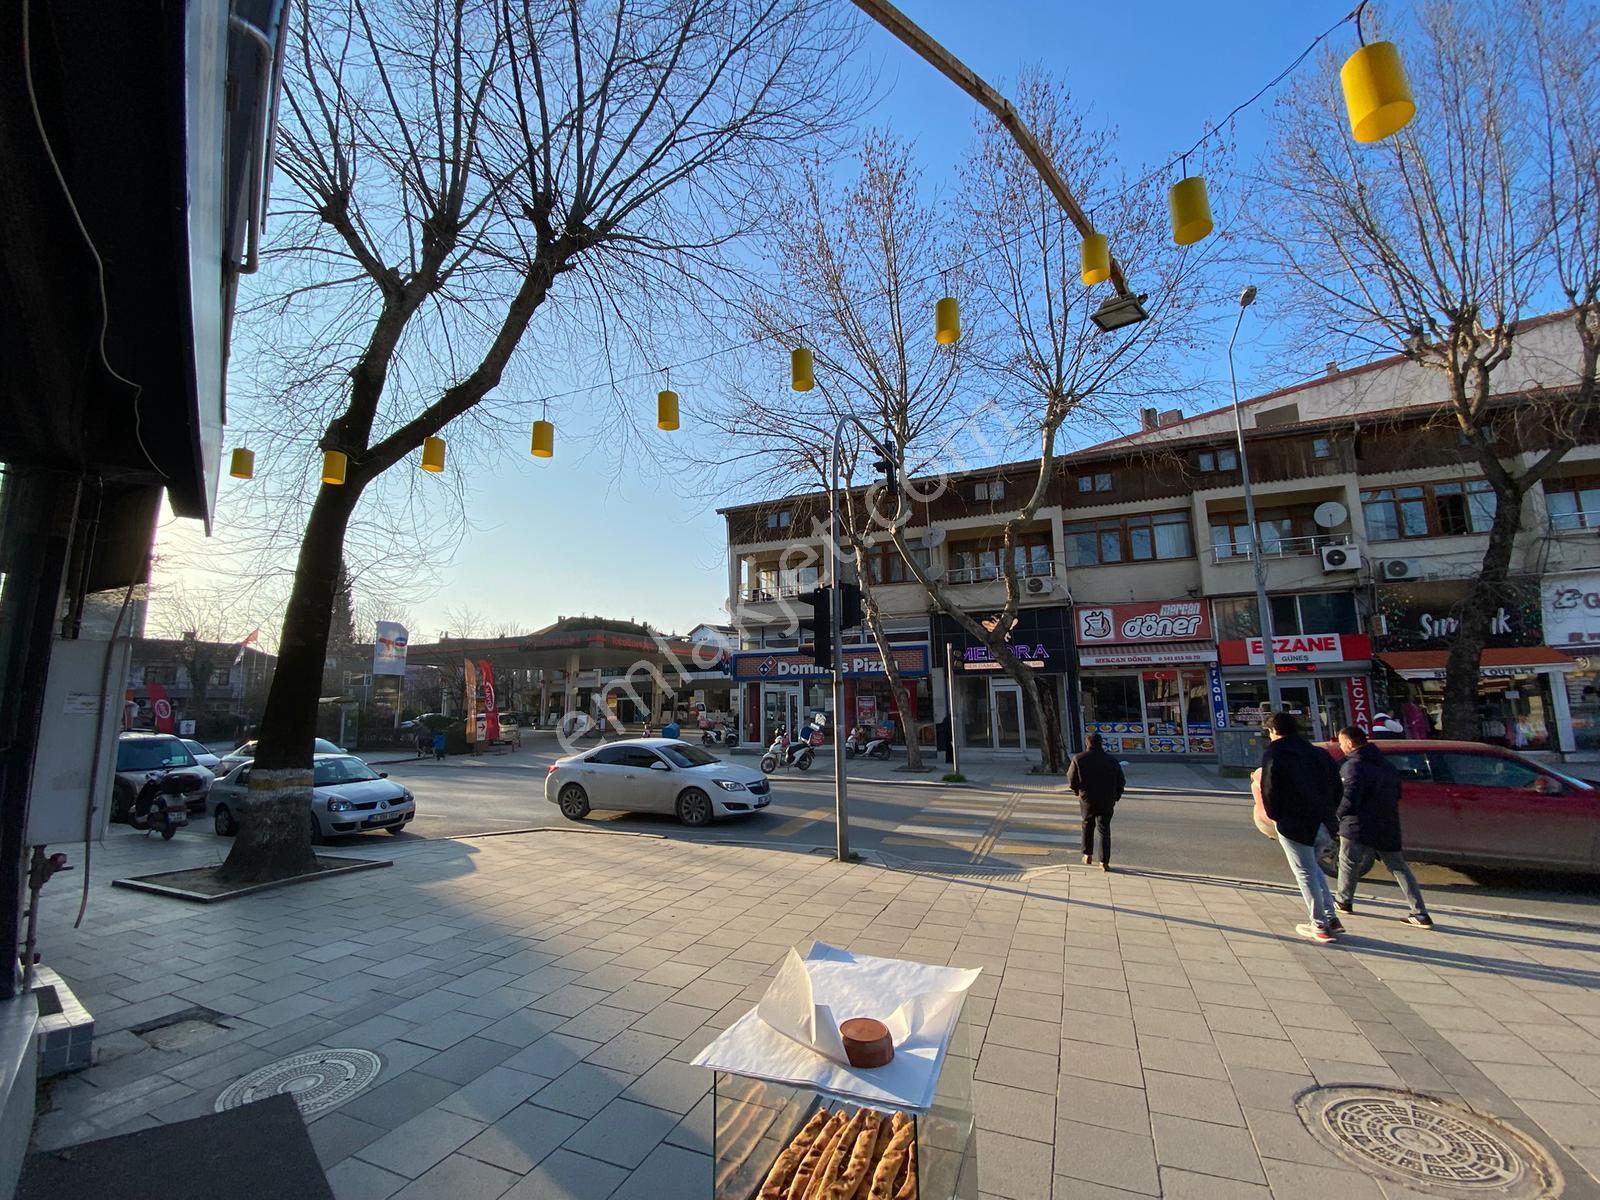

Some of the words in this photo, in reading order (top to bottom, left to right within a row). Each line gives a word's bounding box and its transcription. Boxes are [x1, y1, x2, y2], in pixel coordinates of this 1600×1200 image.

[1160, 603, 1201, 616] mercan
[1122, 613, 1203, 638] döner
[853, 657, 899, 673] Pizz
[1351, 677, 1370, 738] ECZAN
